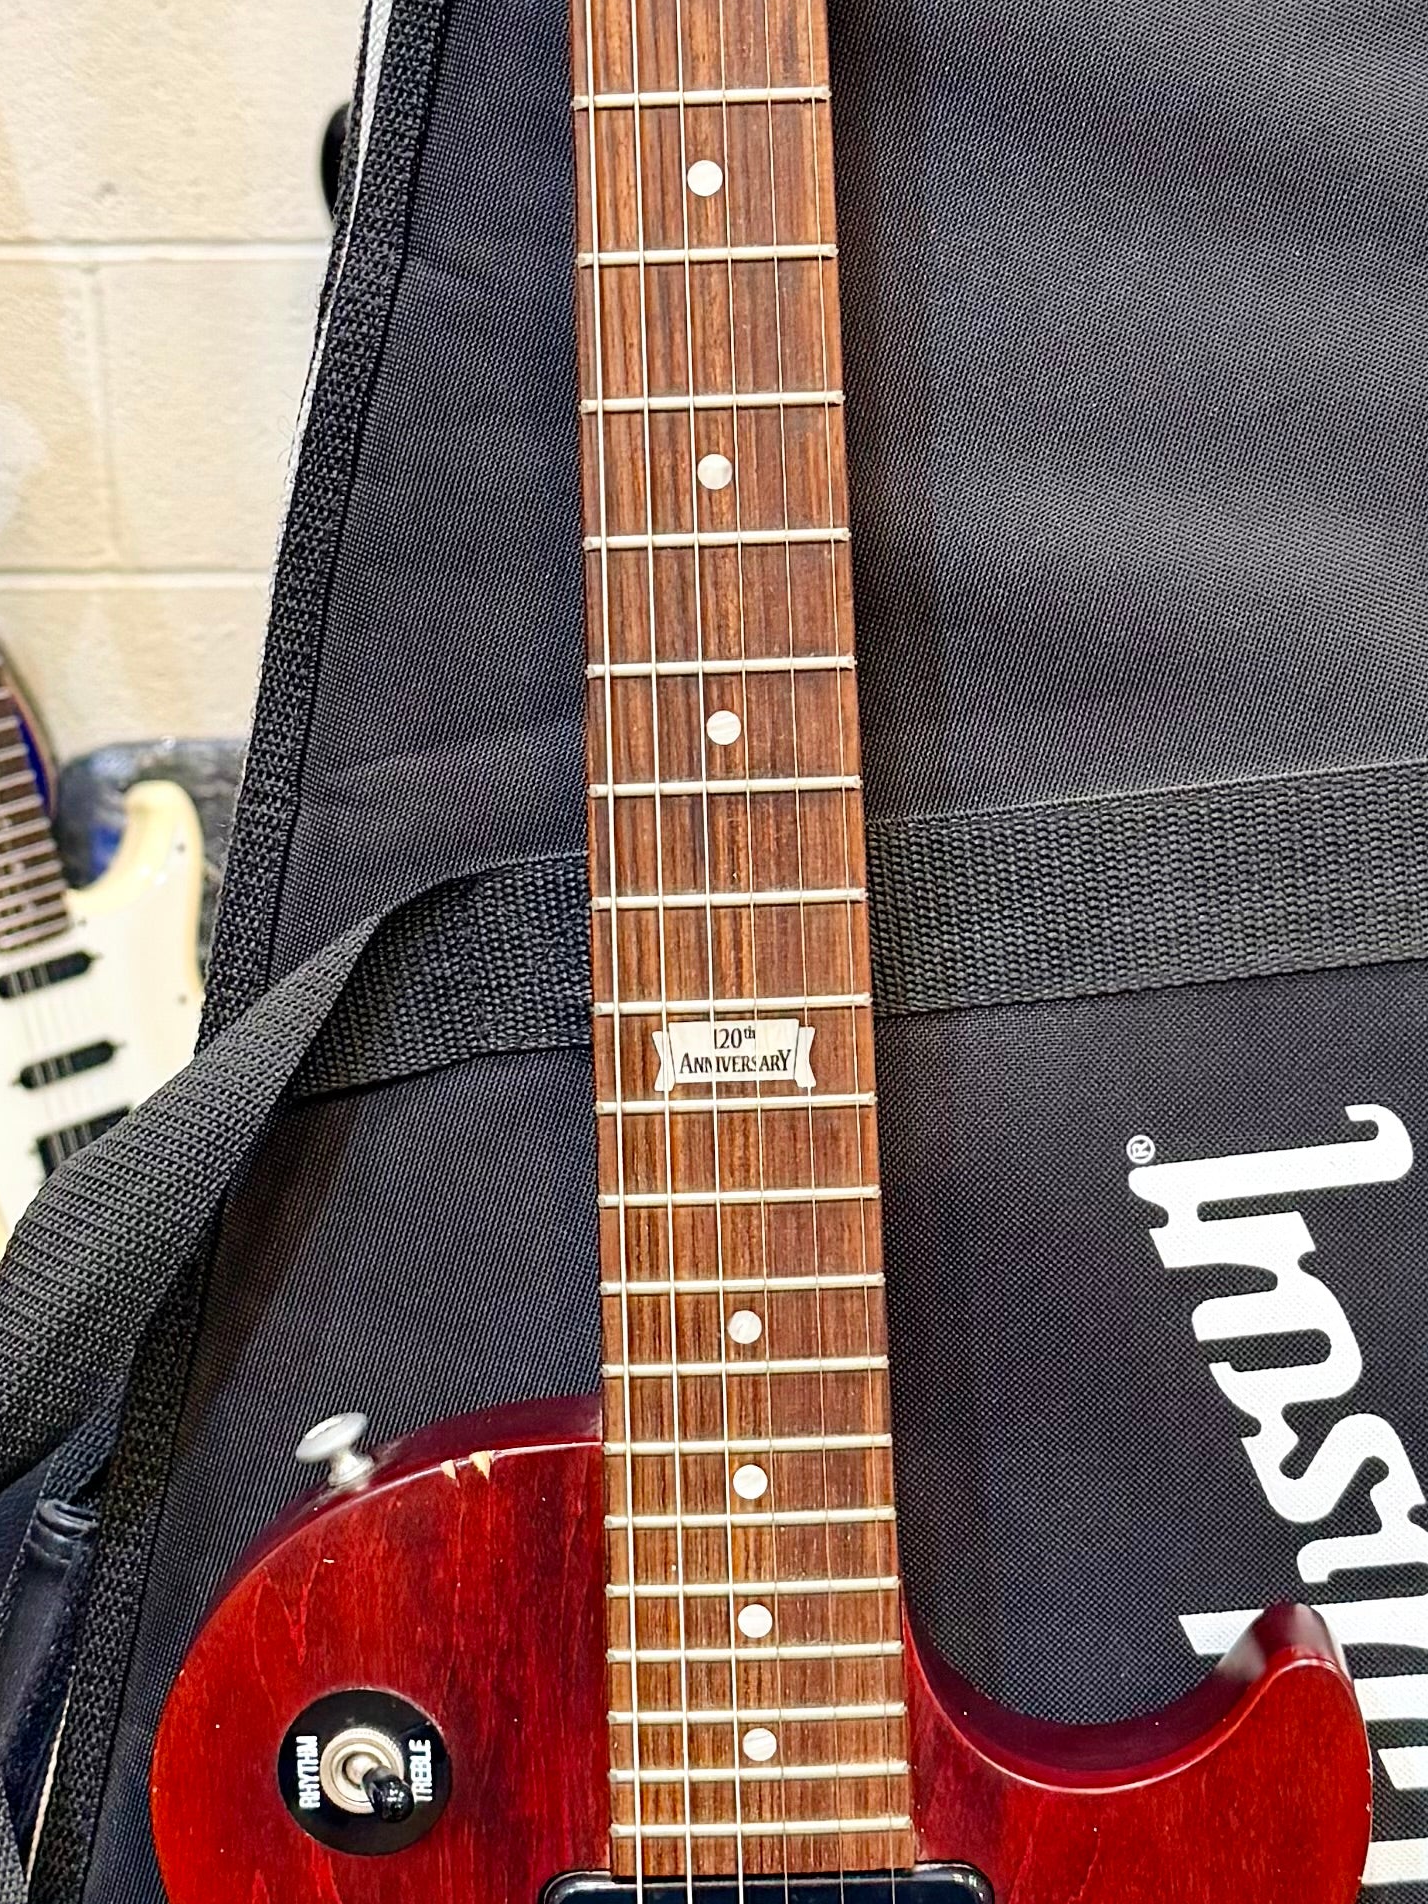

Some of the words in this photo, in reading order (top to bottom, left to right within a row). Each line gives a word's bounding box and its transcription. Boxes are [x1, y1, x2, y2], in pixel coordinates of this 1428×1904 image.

[678, 1049, 792, 1074] ANNIVERSARY
[295, 1735, 321, 1809] RHYTHM
[408, 1739, 433, 1802] TREBLE
